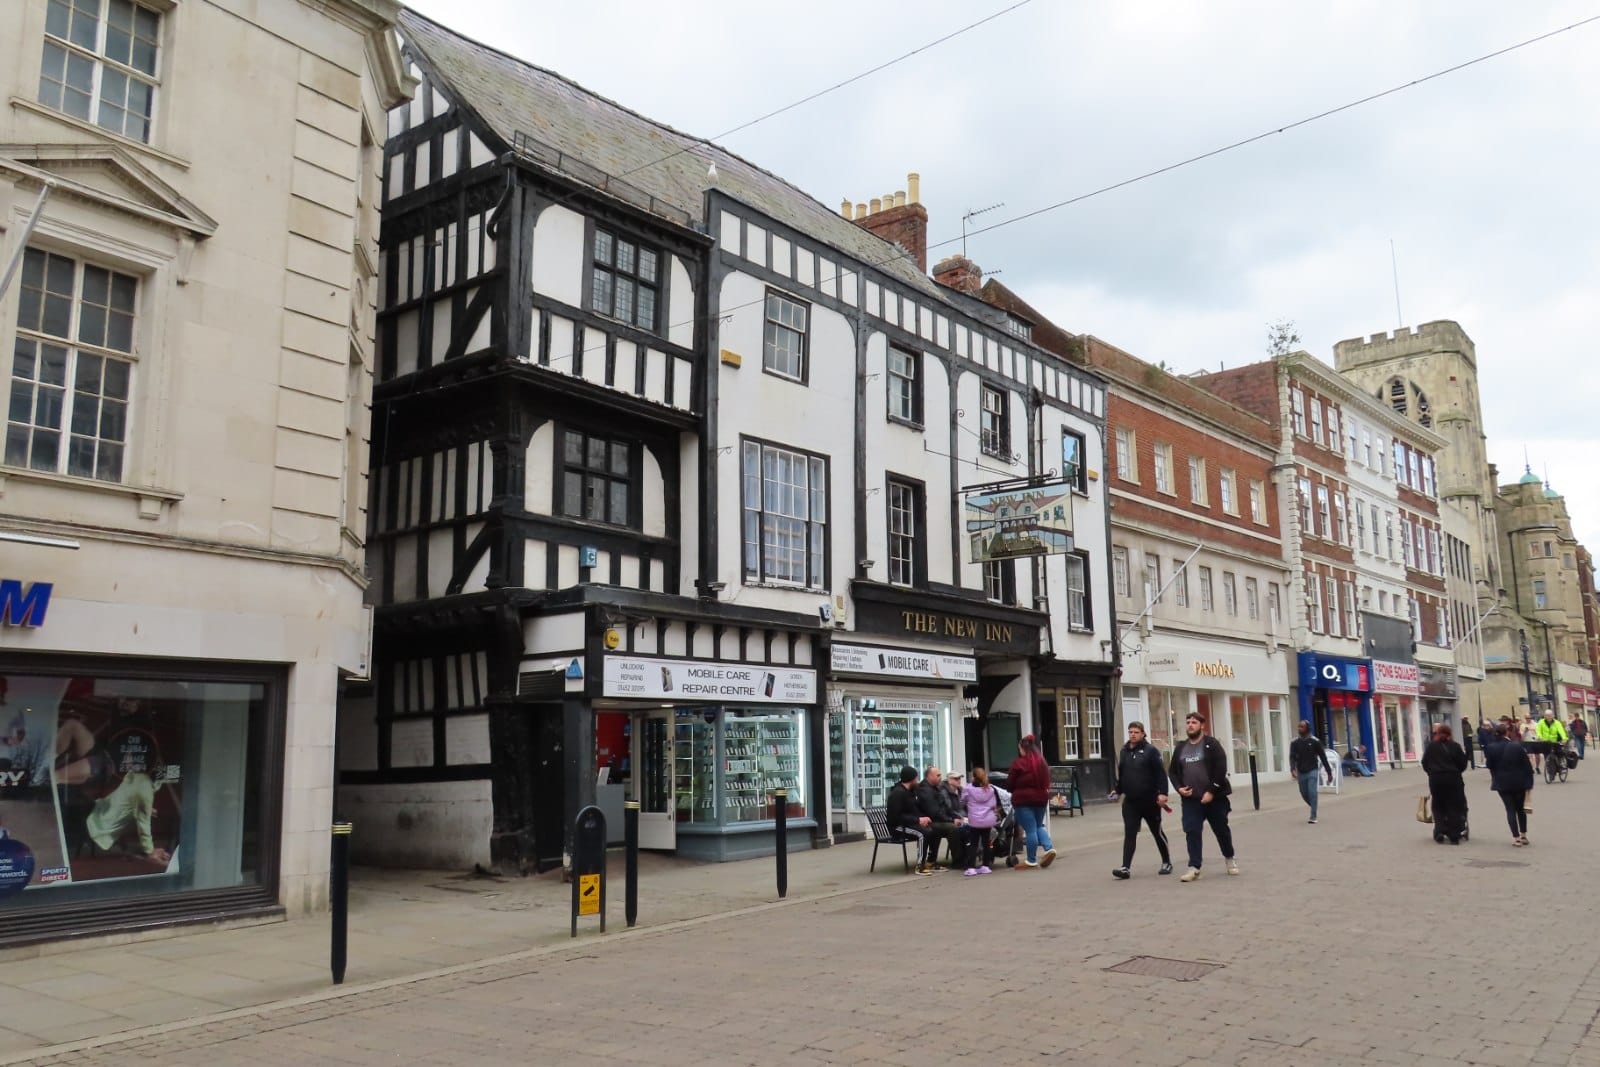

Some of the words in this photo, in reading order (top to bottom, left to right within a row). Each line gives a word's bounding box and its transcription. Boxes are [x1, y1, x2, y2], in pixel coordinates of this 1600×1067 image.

[989, 494, 1018, 507] NEW
[1022, 490, 1046, 503] INN
[902, 611, 937, 634] THE
[944, 617, 979, 638] NEW
[985, 623, 1014, 643] INN
[620, 663, 645, 671] UNLOCKING
[887, 655, 912, 671] MOBILE
[912, 658, 929, 672] CARE
[620, 673, 643, 681] REPAIRING
[687, 668, 725, 680] MOBILE
[726, 670, 751, 681] CARE
[1394, 665, 1417, 680] SQUARE
[682, 683, 718, 695] REPAIR
[719, 685, 756, 696] CENTRE
[41, 868, 68, 876] SPORTS
[41, 874, 67, 882] DIRECT
